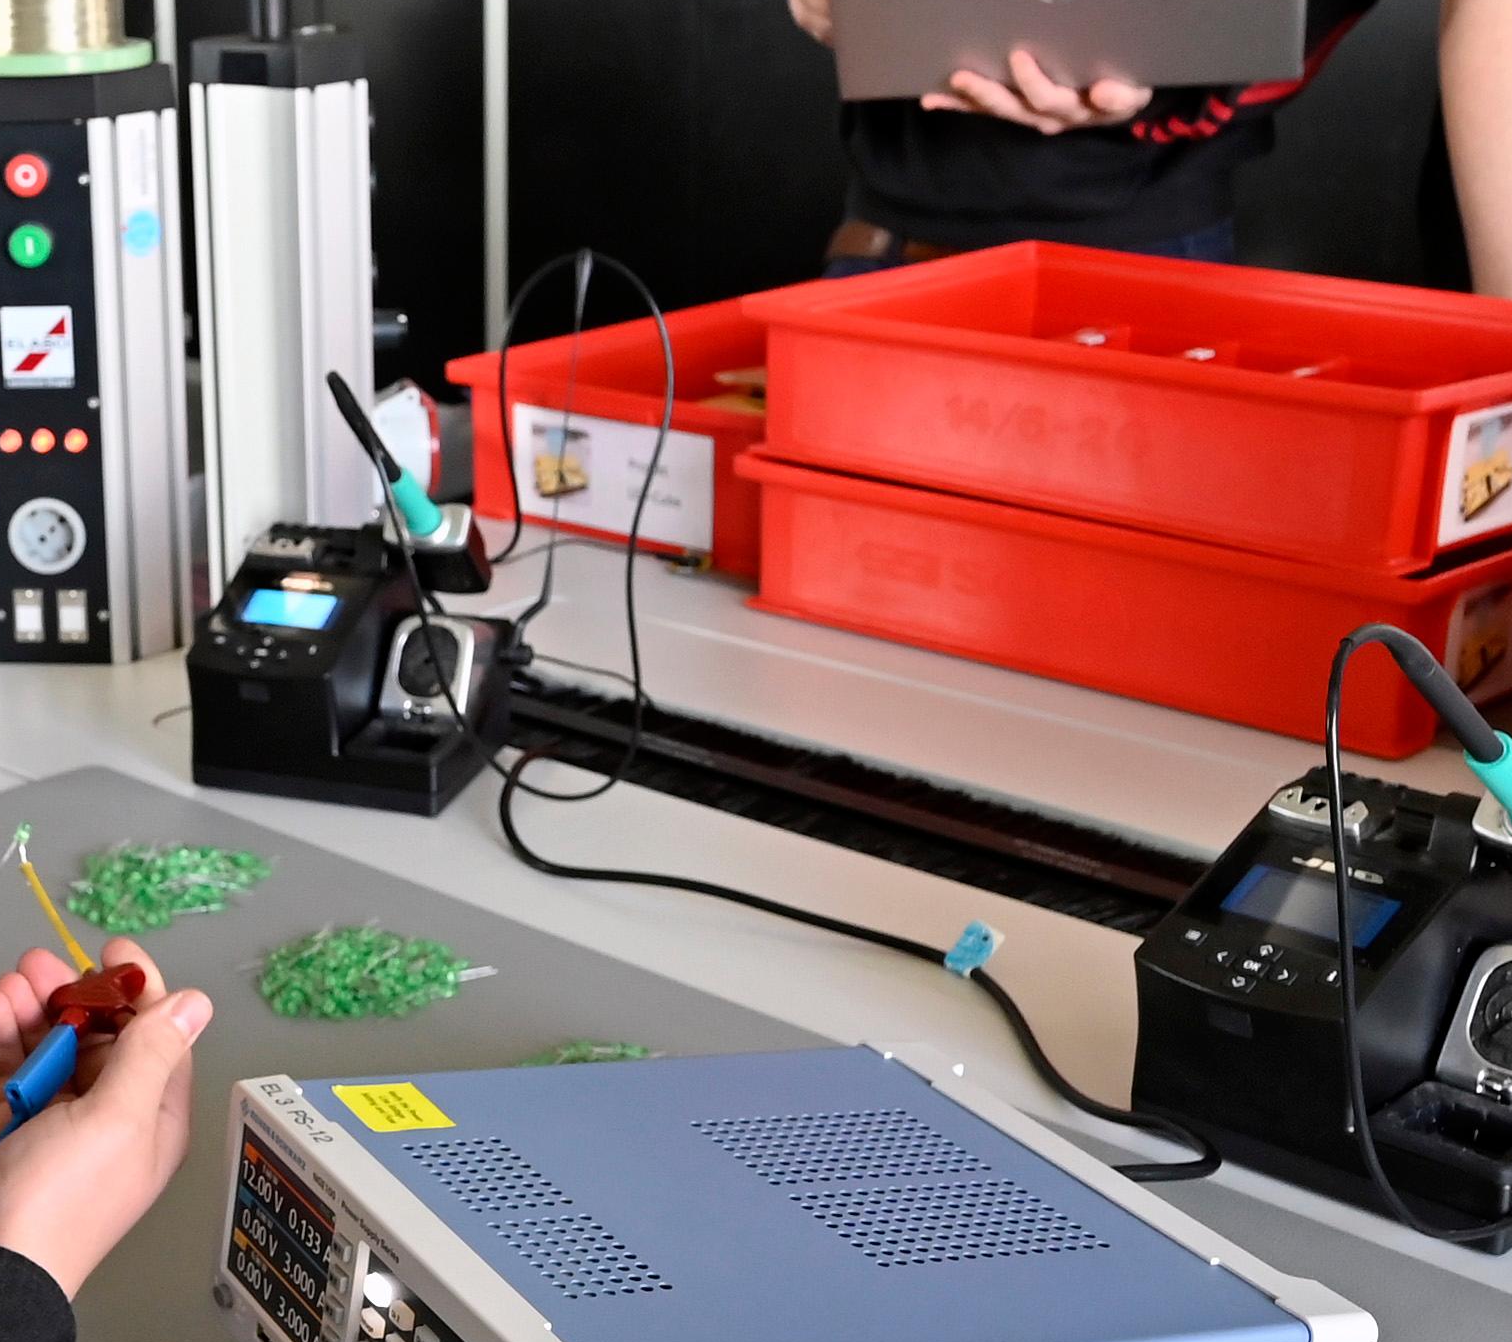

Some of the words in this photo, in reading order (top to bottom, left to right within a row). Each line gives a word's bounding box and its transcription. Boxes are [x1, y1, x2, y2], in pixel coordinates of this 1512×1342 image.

[260, 1083, 282, 1097] EL
[287, 1109, 334, 1144] PS-12
[242, 1160, 273, 1203] 12.00
[274, 1190, 284, 1214] V
[288, 1208, 321, 1255] 0.133
[236, 1252, 262, 1290] 0.00
[263, 1278, 273, 1301] V
[242, 1209, 267, 1247] 0.00
[269, 1234, 278, 1258] V
[282, 1251, 316, 1300] 3.000
